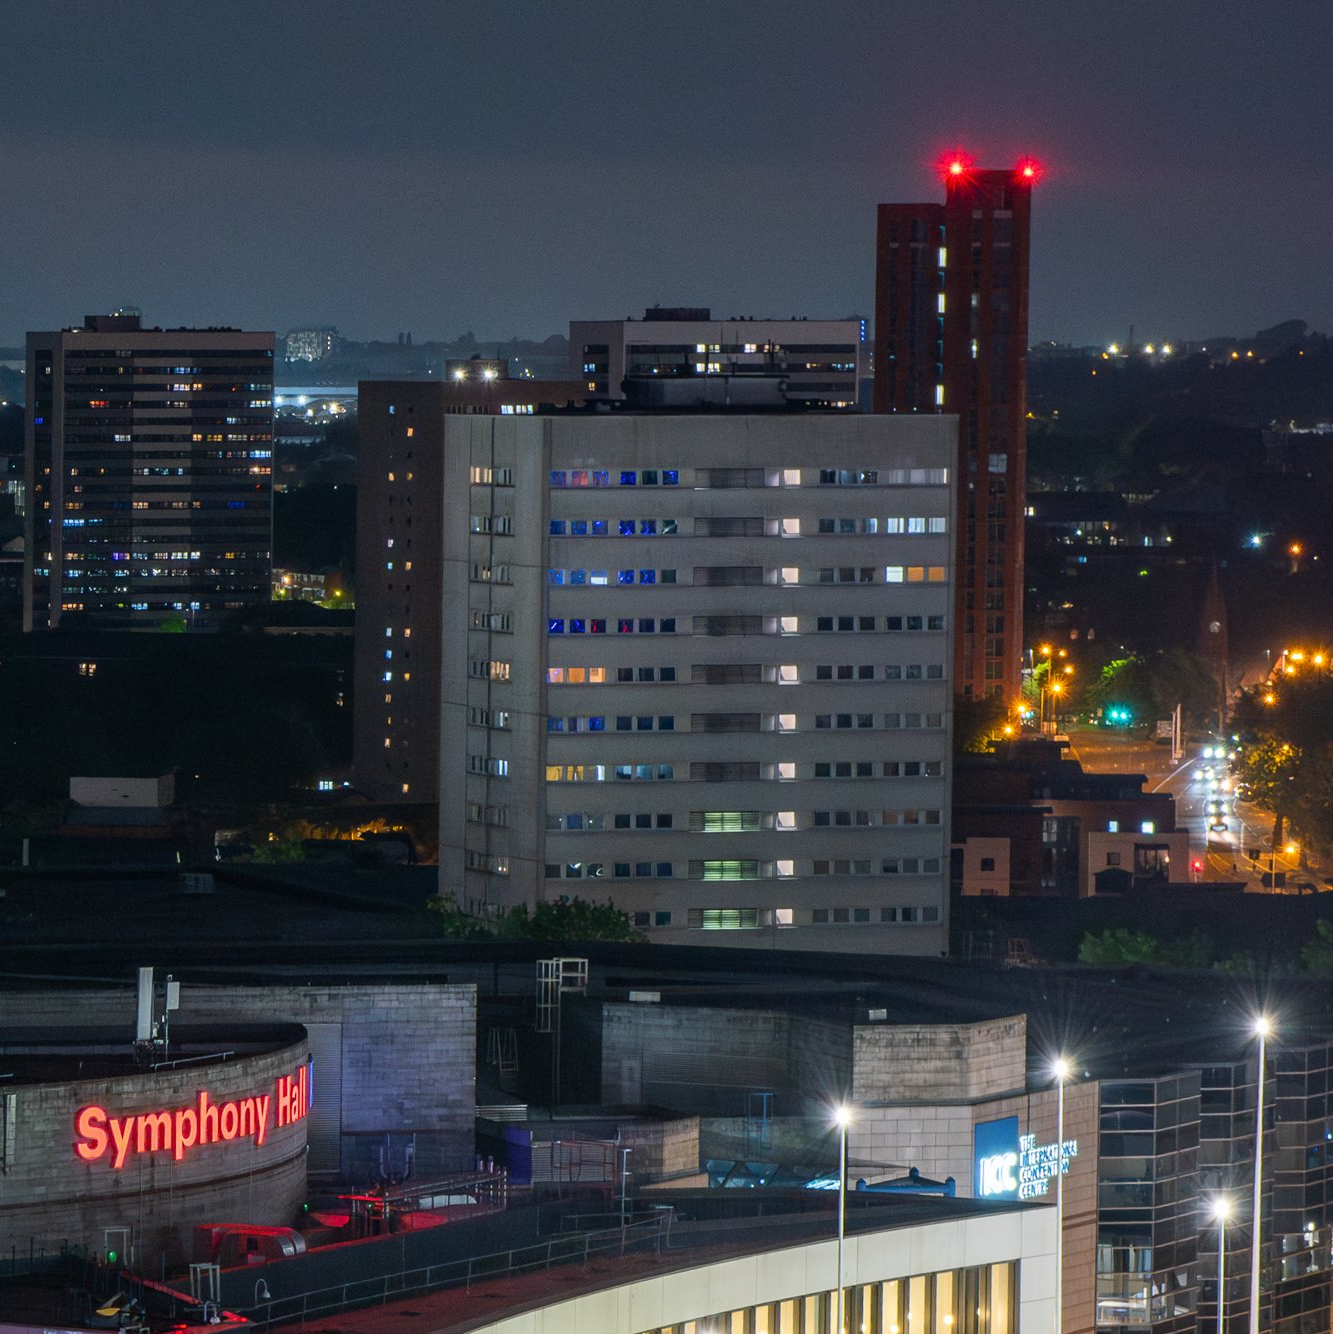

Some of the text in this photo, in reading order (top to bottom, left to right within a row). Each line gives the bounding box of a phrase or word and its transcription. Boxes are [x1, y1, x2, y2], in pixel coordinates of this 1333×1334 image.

[74, 1066, 308, 1169] Symphony Hall
[1019, 1134, 1036, 1152] THE
[1019, 1140, 1078, 1166] INTERNATINAL
[979, 1152, 1018, 1197] ICC
[1019, 1158, 1070, 1183] CONVENTIN
